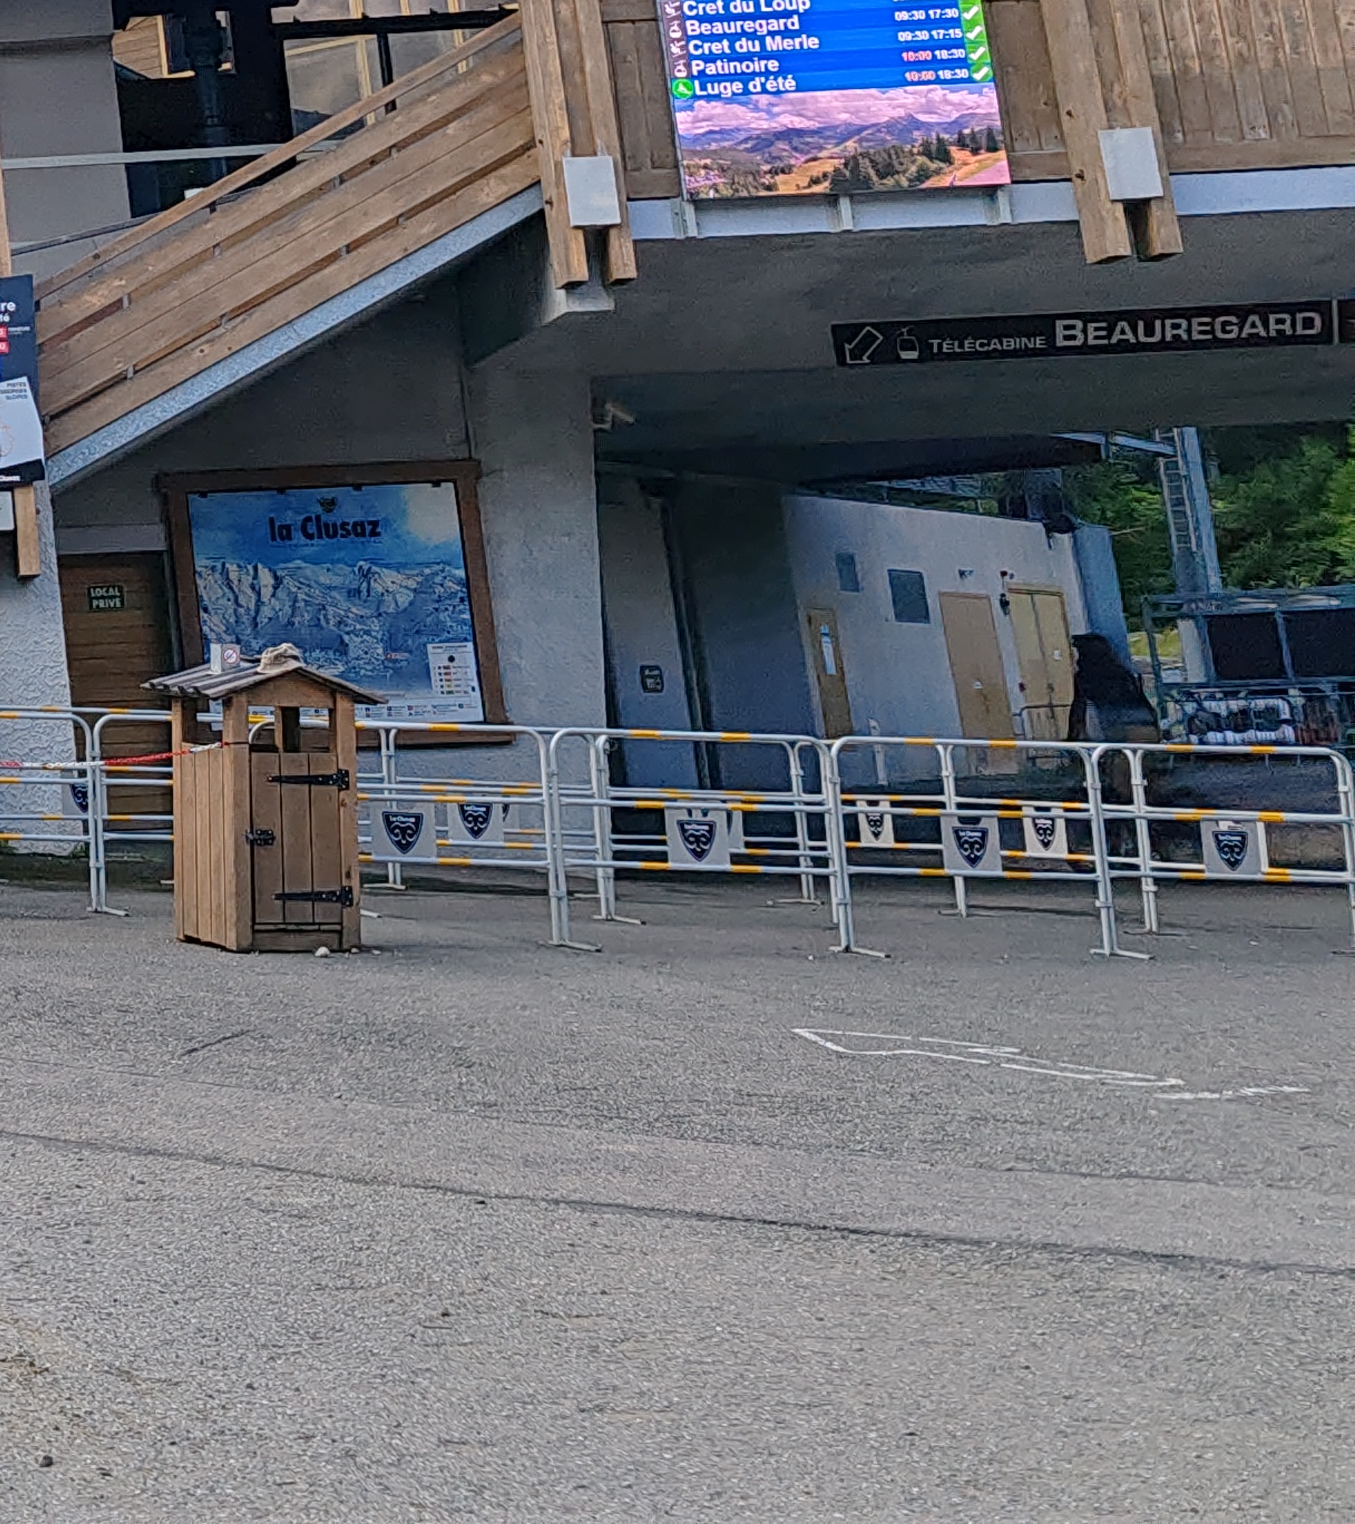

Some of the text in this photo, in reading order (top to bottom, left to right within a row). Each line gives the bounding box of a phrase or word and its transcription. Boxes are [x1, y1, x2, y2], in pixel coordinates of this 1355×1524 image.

[682, 0, 725, 16] Cret
[685, 8, 959, 36] Beauregard 09:30 17:30
[688, 28, 963, 55] Cret du Merle 09:30 17:15
[691, 57, 780, 76] Patinoire
[934, 48, 965, 60] 18:30
[693, 79, 744, 98] Luge
[748, 76, 797, 94] d'été
[937, 69, 969, 80] 18:30
[927, 312, 1322, 354] TÉLÉCABINE BEAUREGARD
[268, 514, 382, 542] la Clusaz
[90, 586, 120, 597] LOCAL
